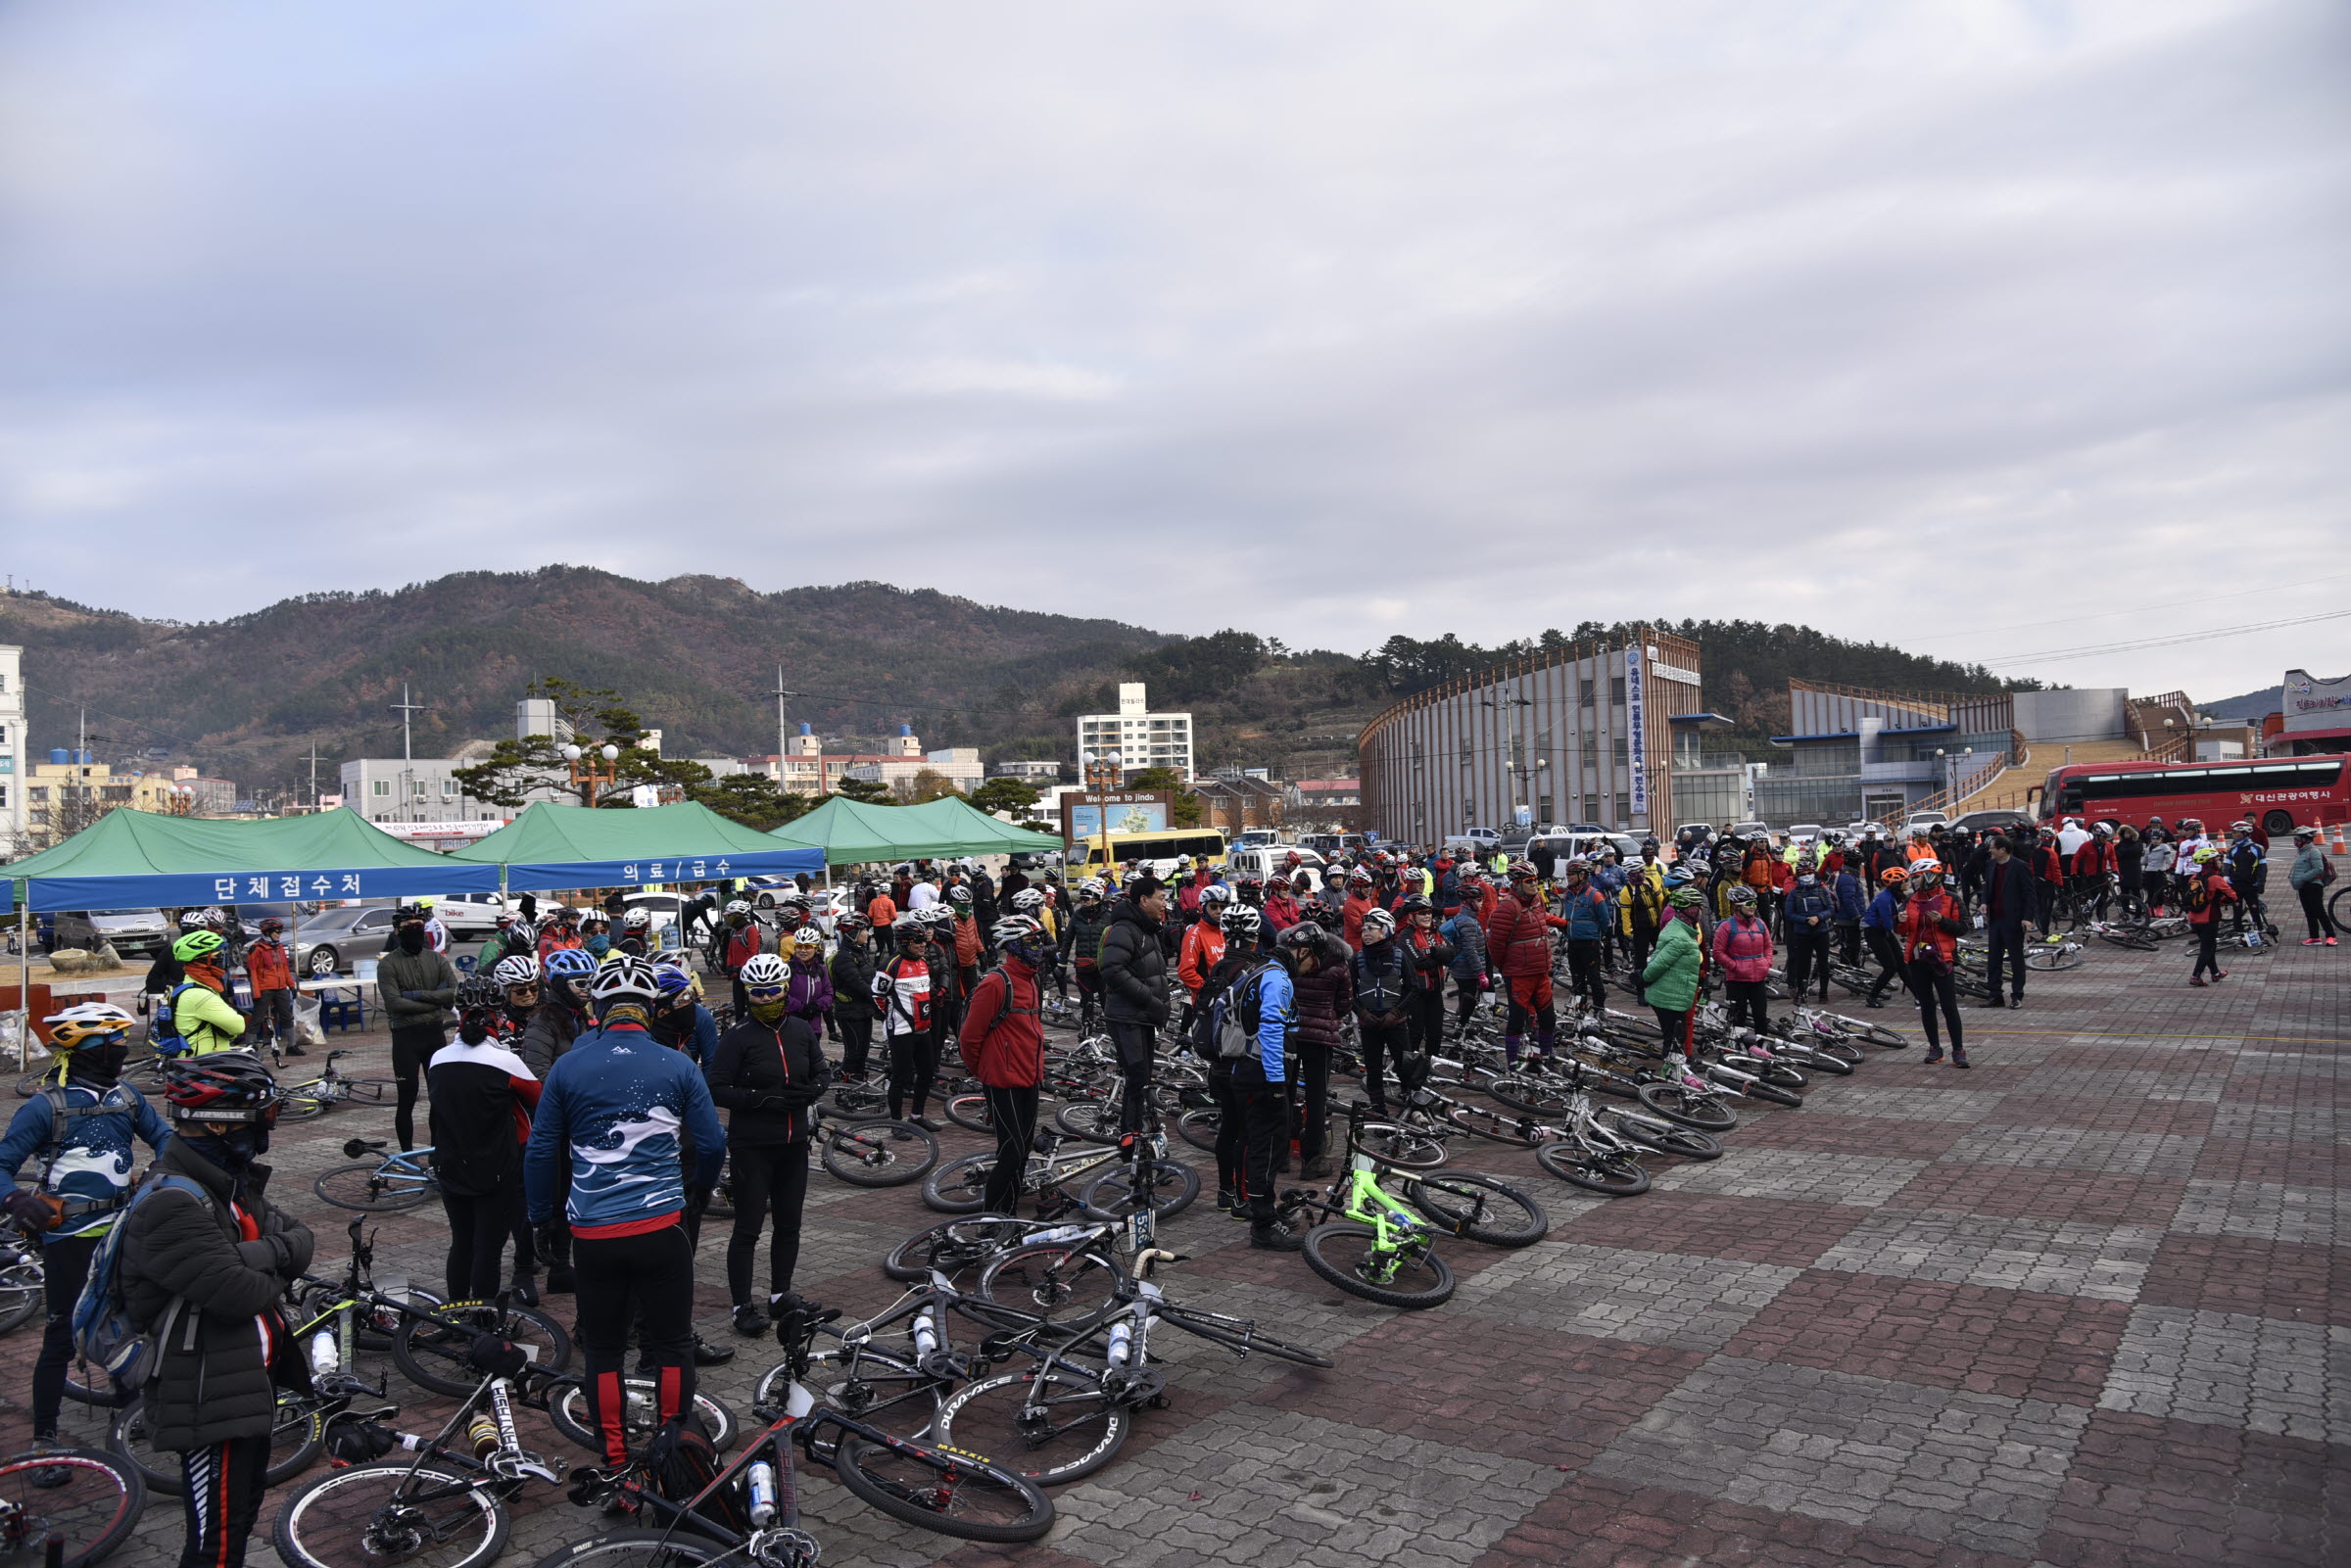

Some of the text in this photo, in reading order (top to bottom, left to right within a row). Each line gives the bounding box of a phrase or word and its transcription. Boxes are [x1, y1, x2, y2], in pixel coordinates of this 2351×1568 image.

[1630, 667, 1641, 701] 유네스코
[1085, 793, 1155, 803] Welome to jindo
[2255, 790, 2331, 803] 대신관광여행사
[215, 873, 361, 900] 단체접수처
[191, 1111, 246, 1119] AIRWALK
[1135, 1213, 1147, 1244] 536
[439, 1300, 484, 1311] MAXXIS
[940, 1375, 1013, 1430] DURA-ACE
[311, 1412, 320, 1442] MAXXIS
[936, 1443, 990, 1464] MAXXIS
[1048, 1416, 1119, 1476] DURA-ACE
